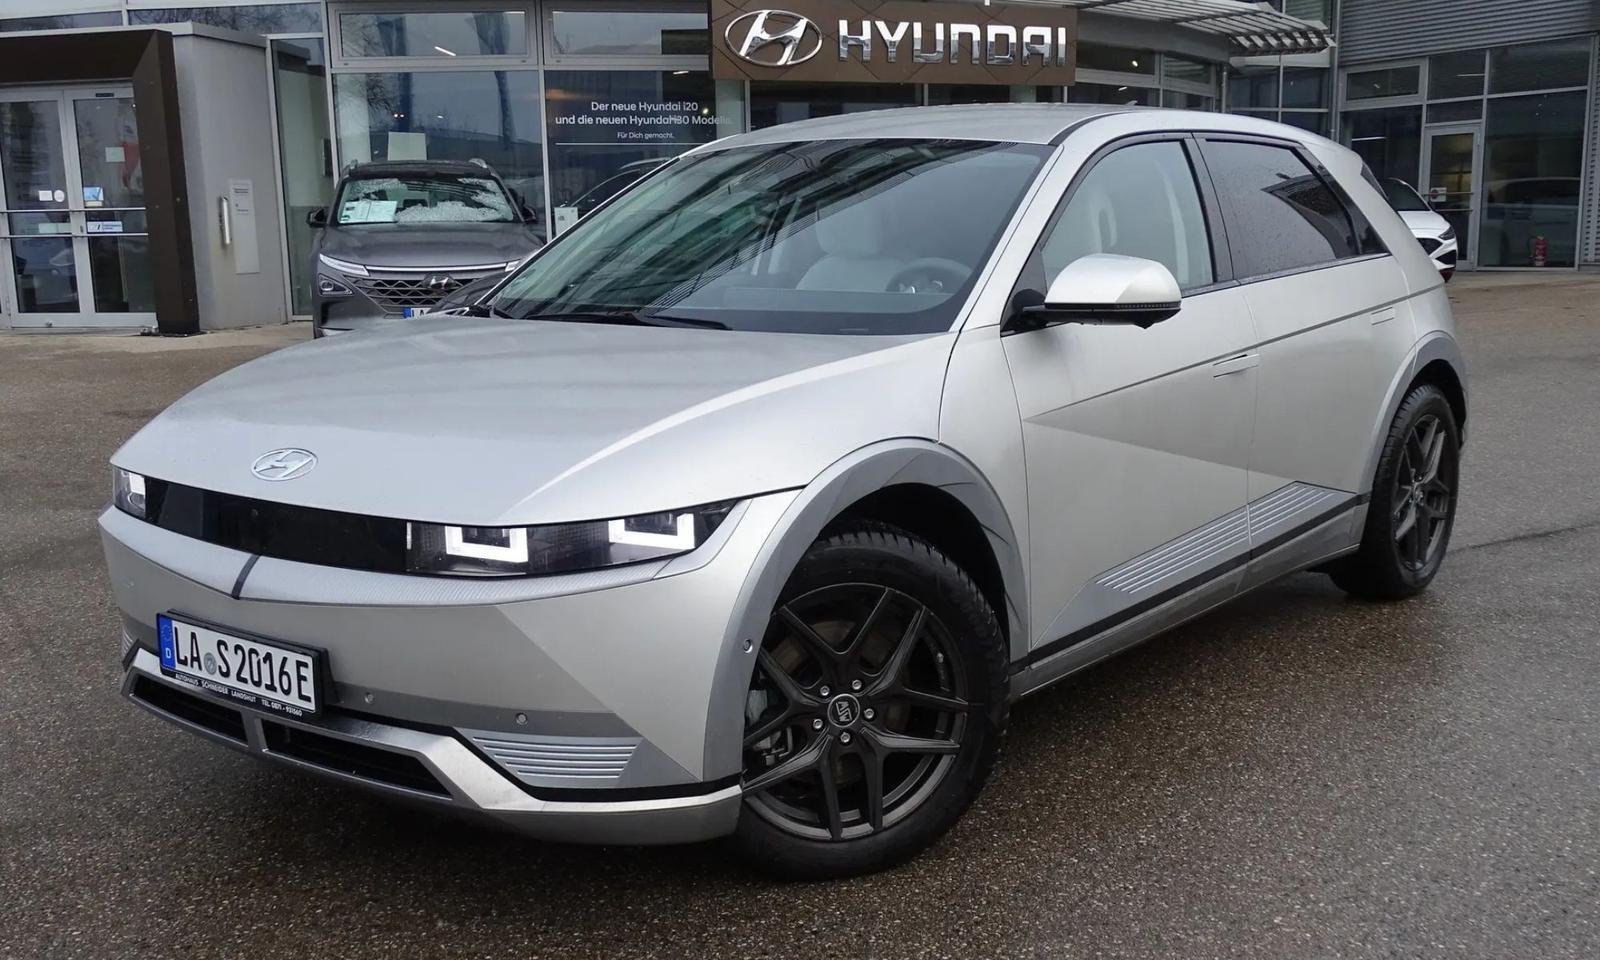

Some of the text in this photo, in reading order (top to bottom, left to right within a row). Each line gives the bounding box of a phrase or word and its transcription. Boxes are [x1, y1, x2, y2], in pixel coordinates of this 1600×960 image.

[838, 19, 1067, 66] HYUNDAI
[591, 101, 699, 113] Der neue Hyundai i20
[555, 114, 575, 125] und
[577, 114, 594, 125] die
[595, 116, 628, 125] neuen
[617, 131, 628, 139] Für
[628, 131, 644, 139] Dich
